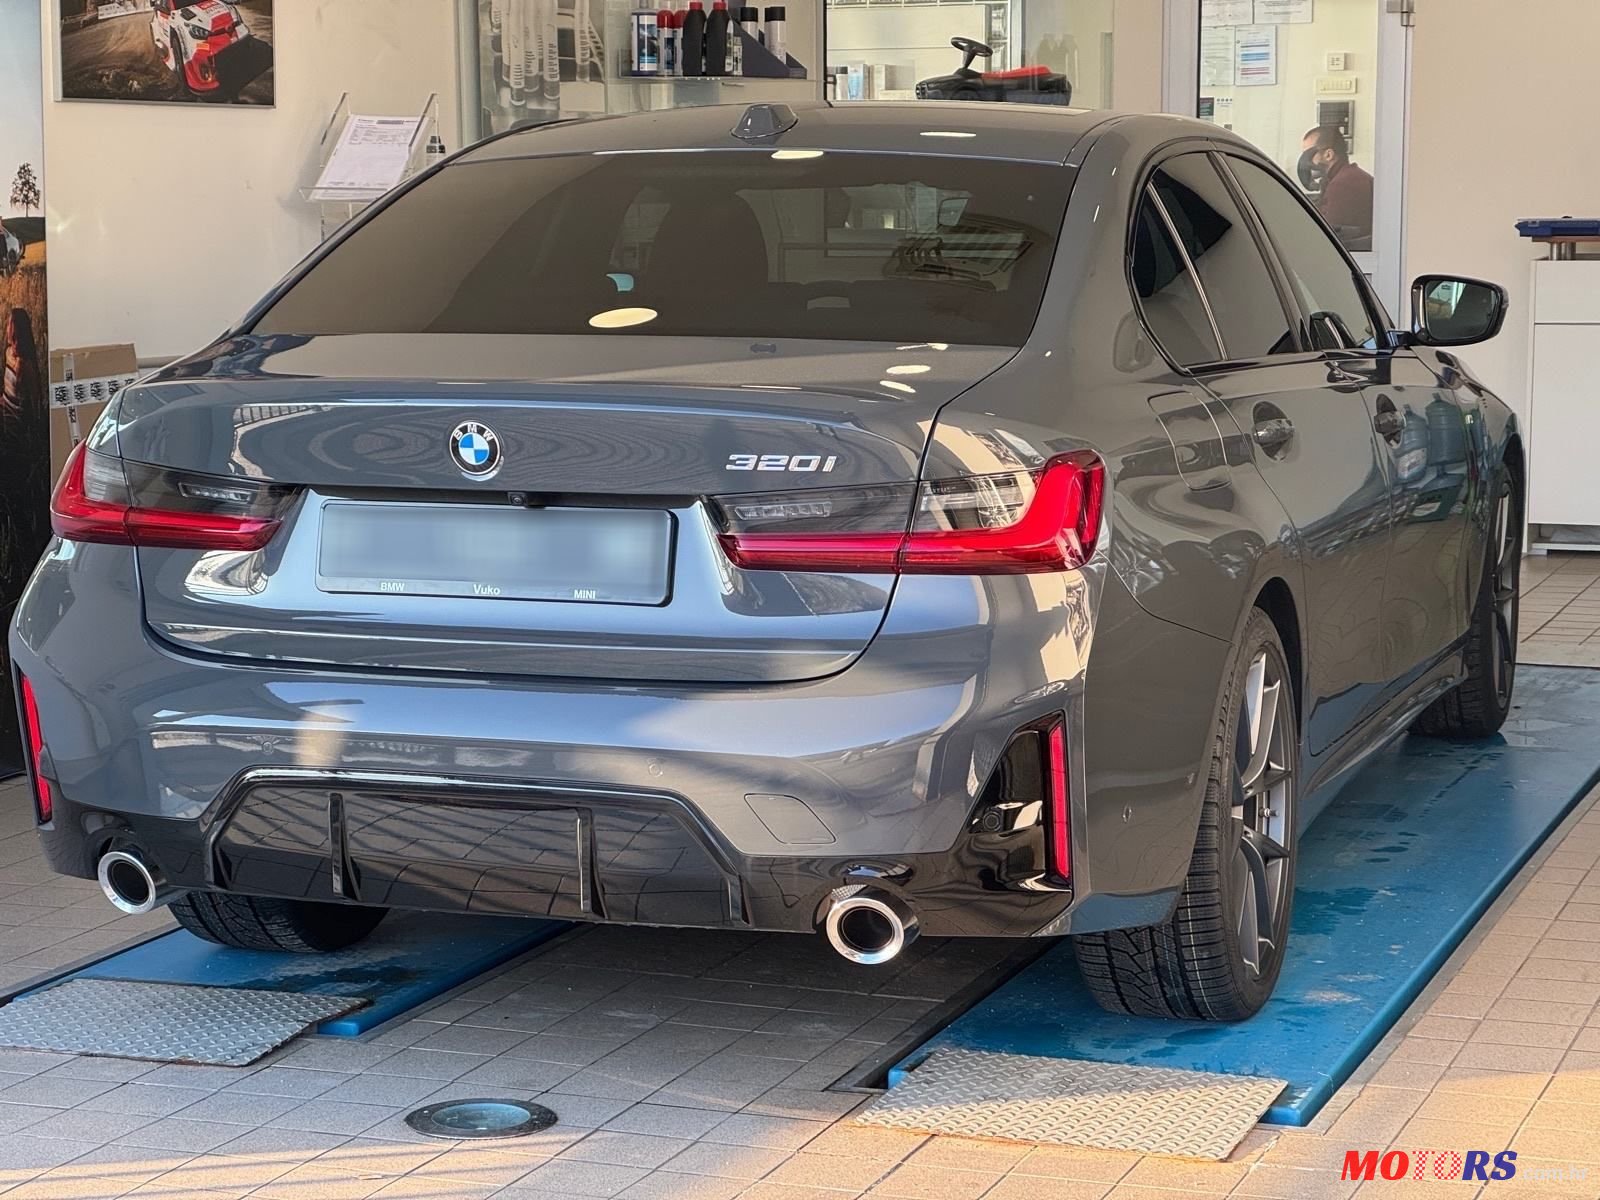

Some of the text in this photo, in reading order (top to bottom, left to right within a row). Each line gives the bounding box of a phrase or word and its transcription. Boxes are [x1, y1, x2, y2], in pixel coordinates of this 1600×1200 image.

[453, 424, 494, 441] BMW
[380, 582, 596, 600] BMW Vuko MINI
